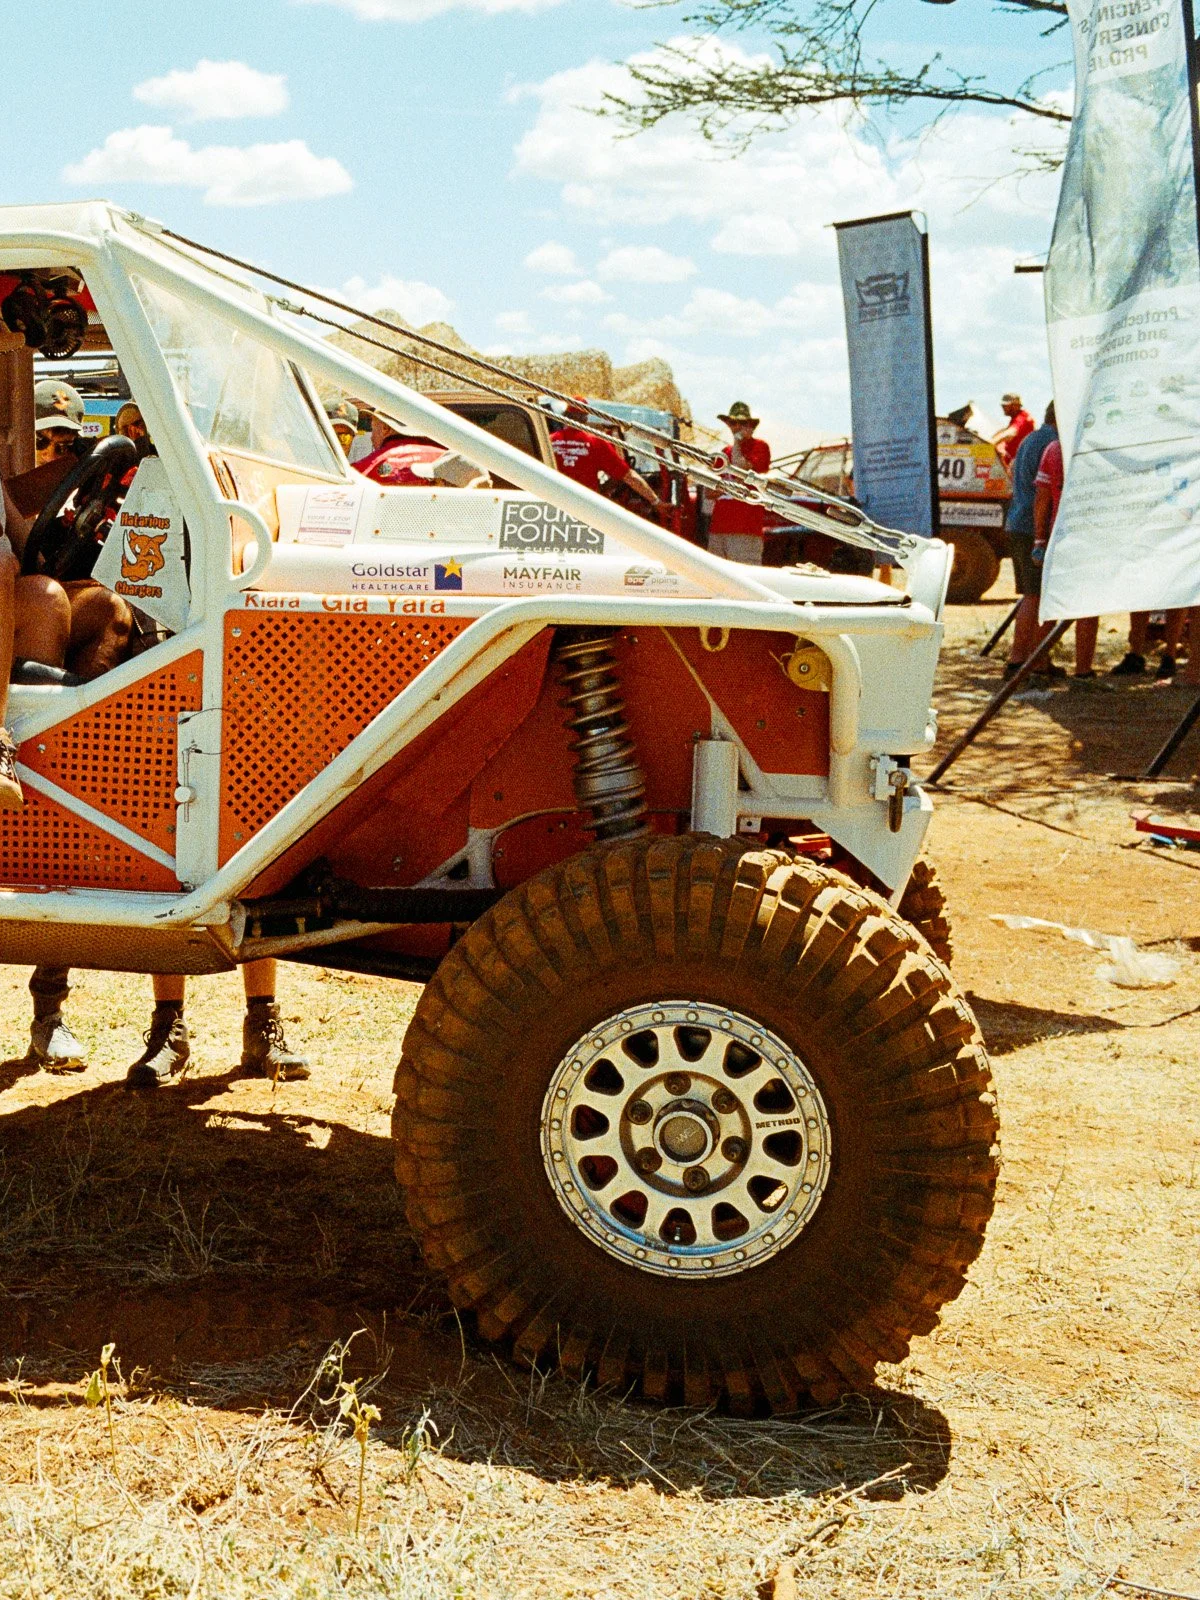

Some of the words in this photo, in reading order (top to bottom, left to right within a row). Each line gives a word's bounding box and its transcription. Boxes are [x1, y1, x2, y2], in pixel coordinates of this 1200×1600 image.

[503, 523, 600, 544] POINTS
[351, 563, 429, 577] Goldstar
[503, 567, 581, 581] MAYFAIR
[351, 583, 430, 591] HEALTHCARE
[502, 581, 582, 591] INSURANCE
[651, 577, 678, 585] piping
[244, 593, 300, 609] Kiara
[321, 594, 369, 612] Gia
[385, 595, 445, 614] Yara
[755, 1117, 801, 1130] METHOD
